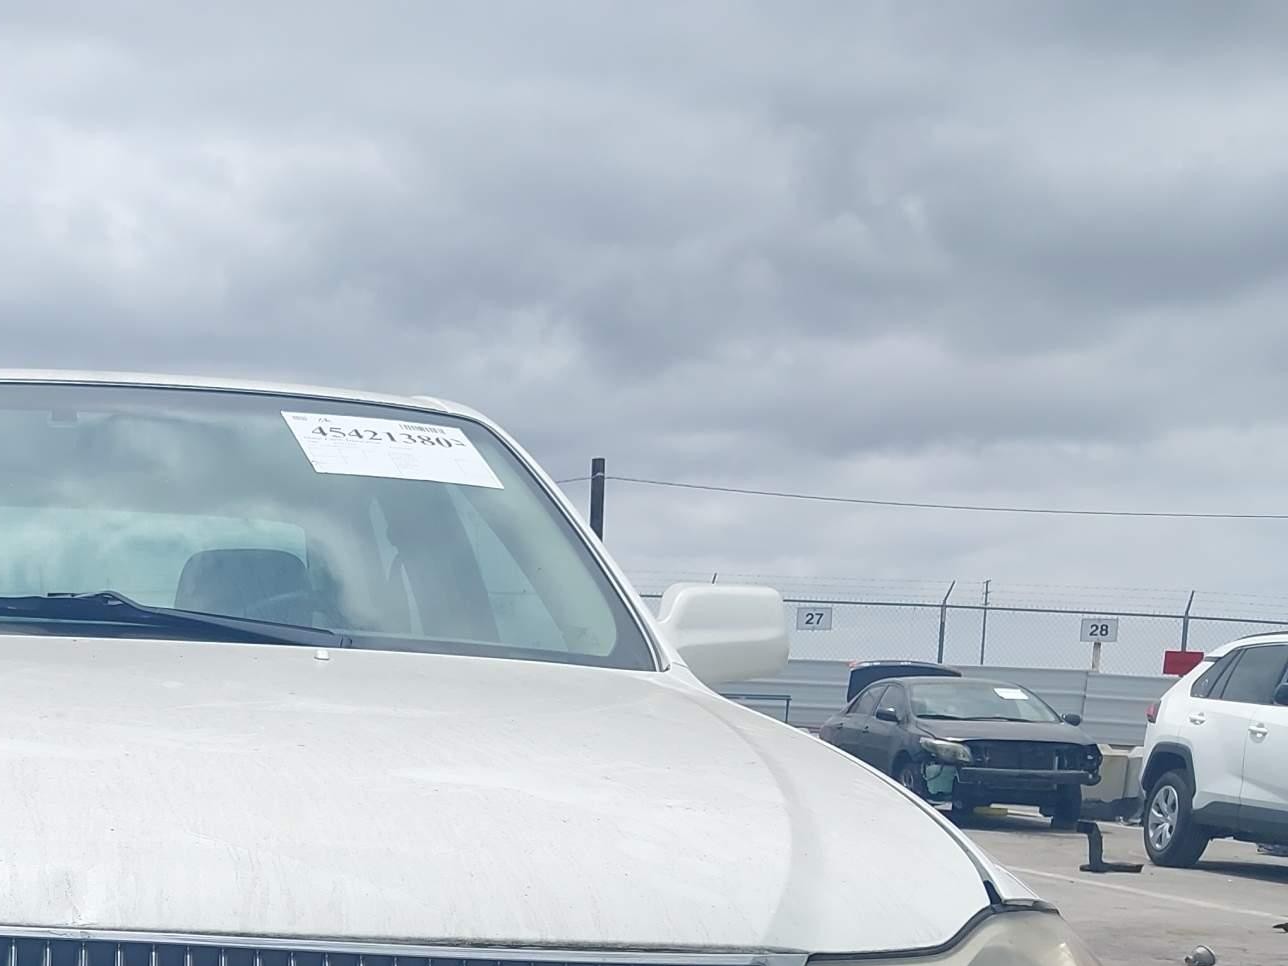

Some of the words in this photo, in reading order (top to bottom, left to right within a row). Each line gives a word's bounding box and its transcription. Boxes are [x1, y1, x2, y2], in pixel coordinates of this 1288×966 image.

[311, 425, 453, 449] 45421380
[804, 612, 825, 626] 27
[1088, 623, 1110, 637] 28
